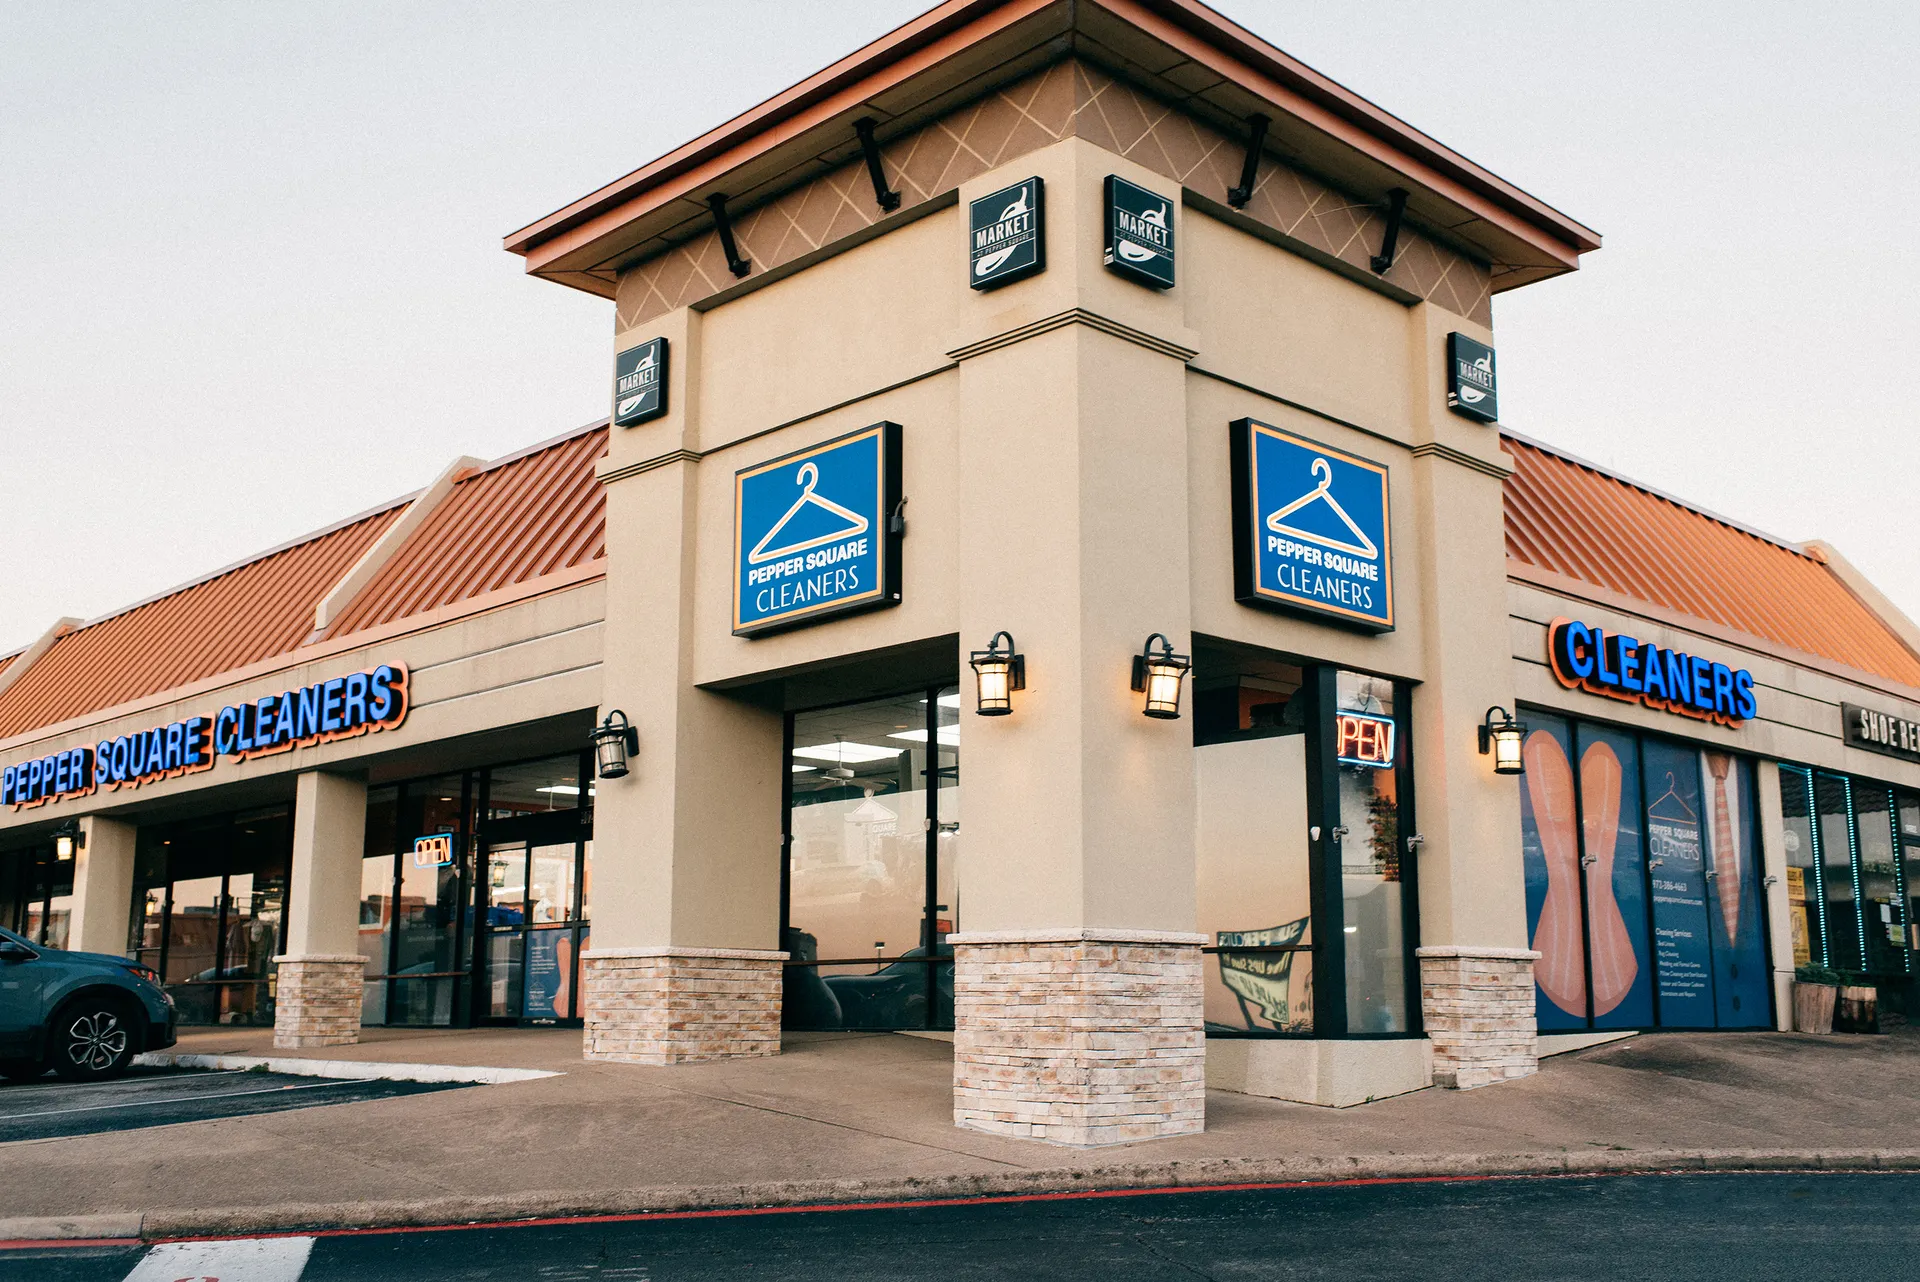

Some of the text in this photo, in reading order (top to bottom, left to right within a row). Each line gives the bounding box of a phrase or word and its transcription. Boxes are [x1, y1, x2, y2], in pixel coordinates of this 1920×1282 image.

[976, 212, 1030, 249] MARKET
[1119, 211, 1168, 247] MARKET
[620, 366, 655, 393] MARKET
[1460, 362, 1493, 388] MARKET
[749, 538, 868, 586] PEPPER SQUARE
[1267, 536, 1379, 581] PEPPER SQUARE
[756, 565, 859, 613] CLEANERS
[1277, 564, 1373, 609] CLEANERS
[1566, 620, 1758, 720] CLEANERS
[2, 664, 398, 804] PEPPER SQUARE CLEANERS
[1336, 716, 1392, 763] PEN
[1861, 709, 1898, 747] SHOE
[1648, 823, 1698, 840] PEPPER SQUARE
[1649, 837, 1699, 860] CLEANERS
[416, 838, 450, 865] OPEN
